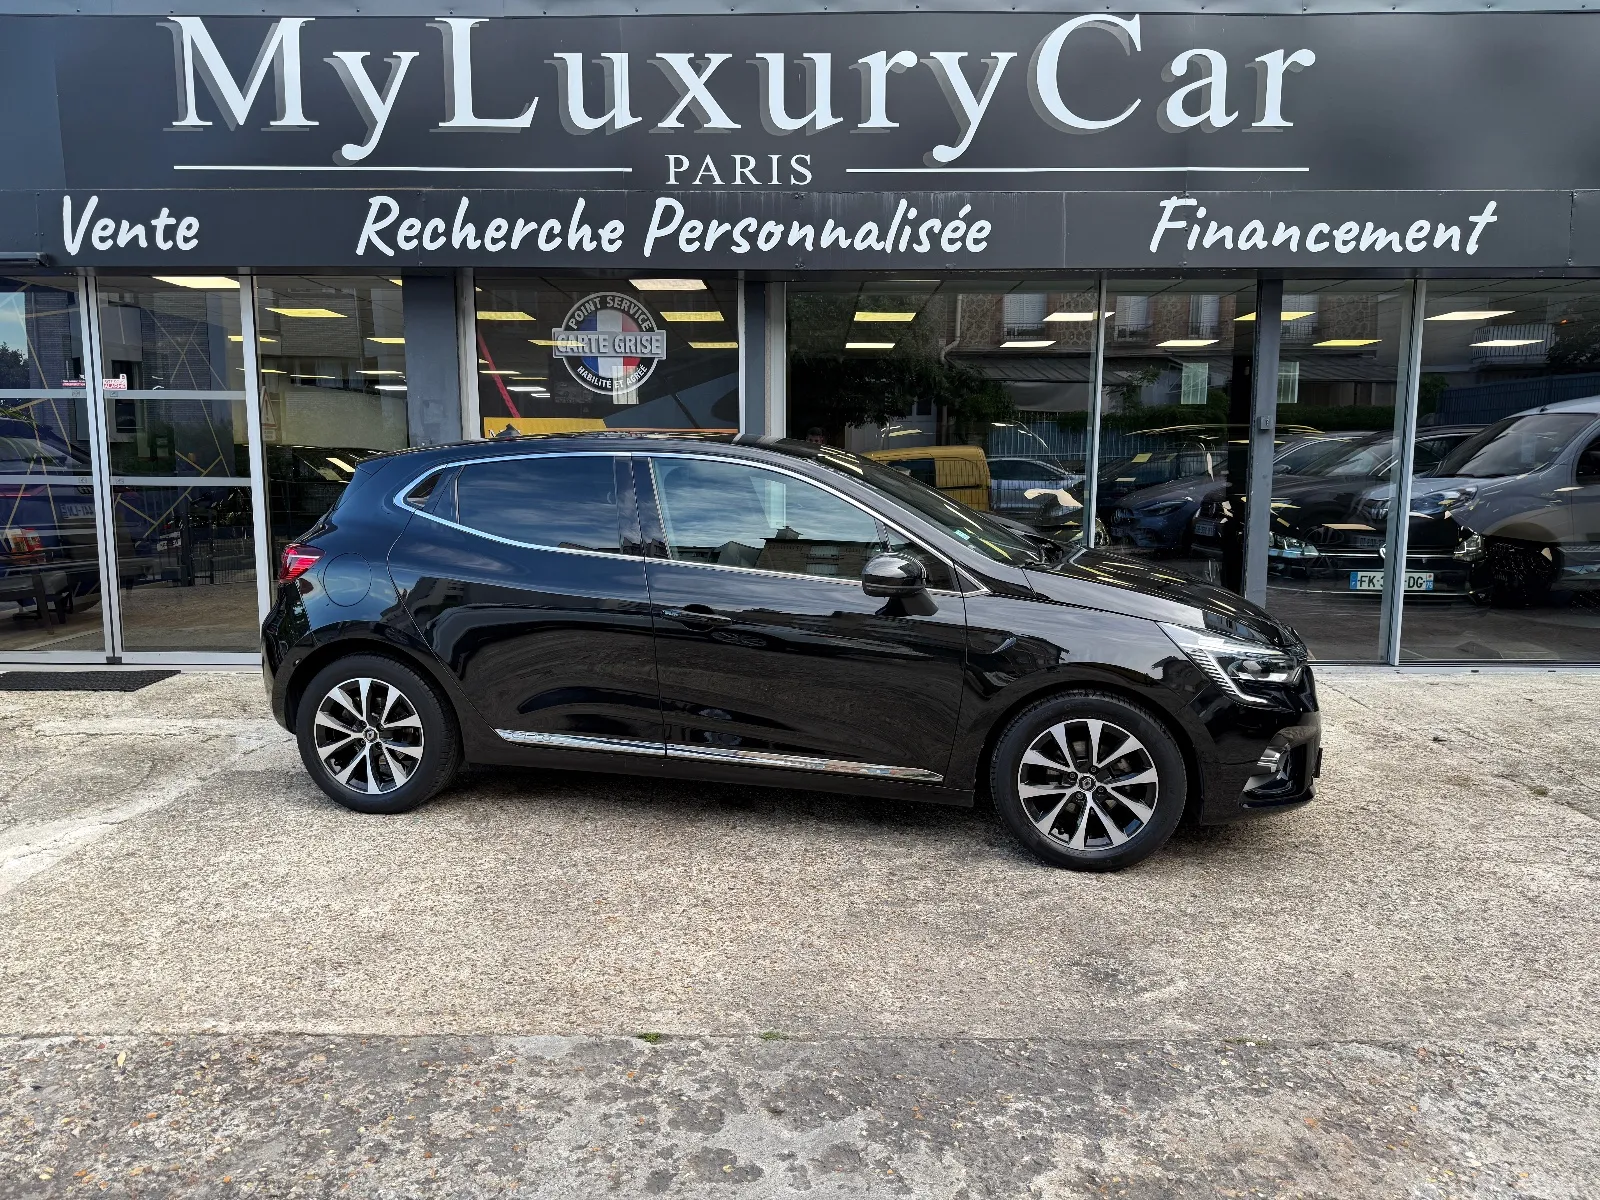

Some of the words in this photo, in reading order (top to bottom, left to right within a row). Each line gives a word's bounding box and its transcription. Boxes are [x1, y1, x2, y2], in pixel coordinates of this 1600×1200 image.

[167, 14, 1315, 163] MyLuxuryCar
[664, 154, 813, 186] PARIS
[62, 195, 200, 256] Vente
[355, 195, 625, 257] Recherche
[643, 196, 992, 258] Personnalisée
[1149, 195, 1498, 256] Financement
[568, 297, 602, 330] POINT
[606, 296, 652, 332] SERVICE
[557, 334, 609, 353] CARTE
[614, 335, 662, 354] GRISE
[614, 379, 624, 389] ET
